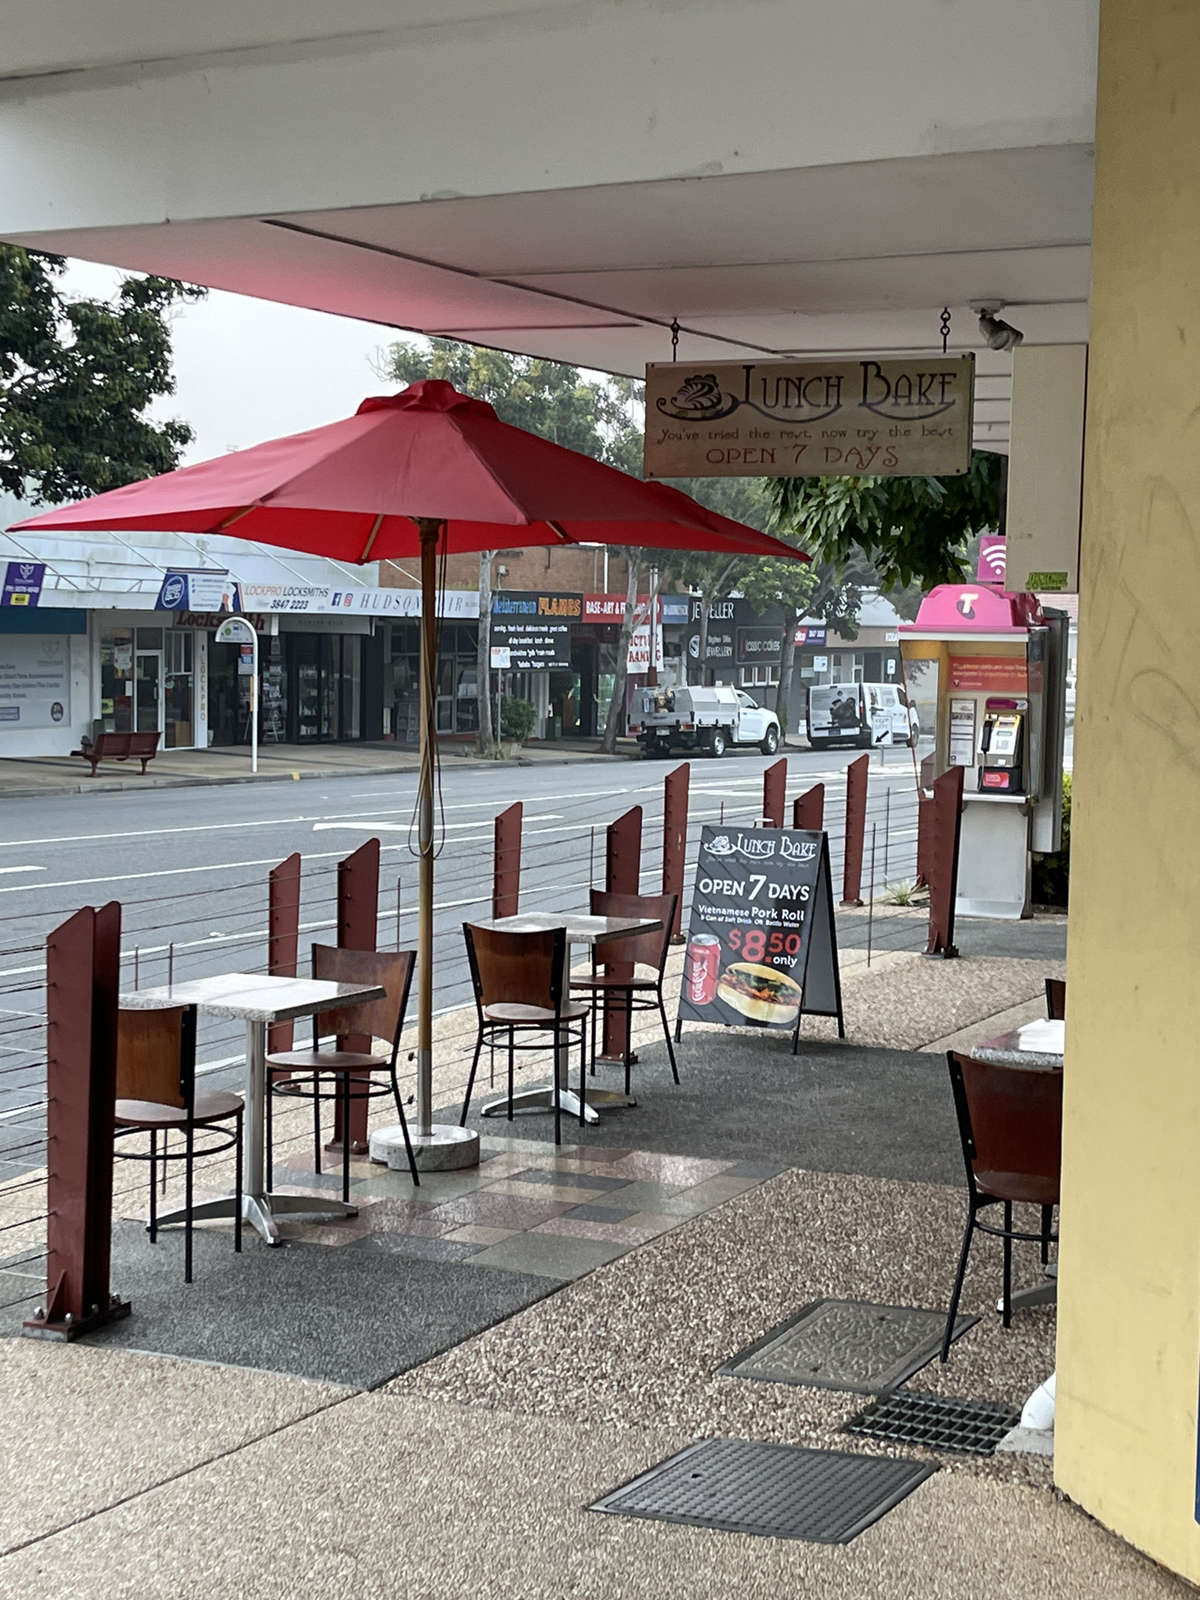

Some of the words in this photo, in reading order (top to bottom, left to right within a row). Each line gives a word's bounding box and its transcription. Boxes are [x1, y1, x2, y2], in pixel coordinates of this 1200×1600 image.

[741, 364, 845, 412] LUNCH
[858, 360, 958, 411] BAKE
[657, 428, 699, 444] You've
[708, 427, 739, 441] tried
[749, 426, 771, 440] the
[821, 428, 848, 439] now
[856, 427, 879, 441] try
[888, 424, 911, 438] the
[921, 423, 953, 437] best
[706, 447, 777, 465] OPEN
[790, 444, 808, 464] 7
[824, 444, 899, 470] DAYS
[283, 587, 329, 598] LOCKSMITHS
[270, 599, 290, 609] 3847
[290, 600, 309, 610] 2223
[691, 601, 734, 622] JEELLER
[735, 833, 776, 857] LUNCH
[780, 836, 817, 860] BAKE
[699, 878, 746, 897] OPEN
[748, 874, 767, 901] 7
[768, 884, 810, 902] DAYS
[698, 905, 750, 917] Vietnamese
[751, 906, 778, 919] Pork
[781, 908, 805, 921] Roll
[754, 918, 763, 926] OR
[773, 955, 798, 968] only
